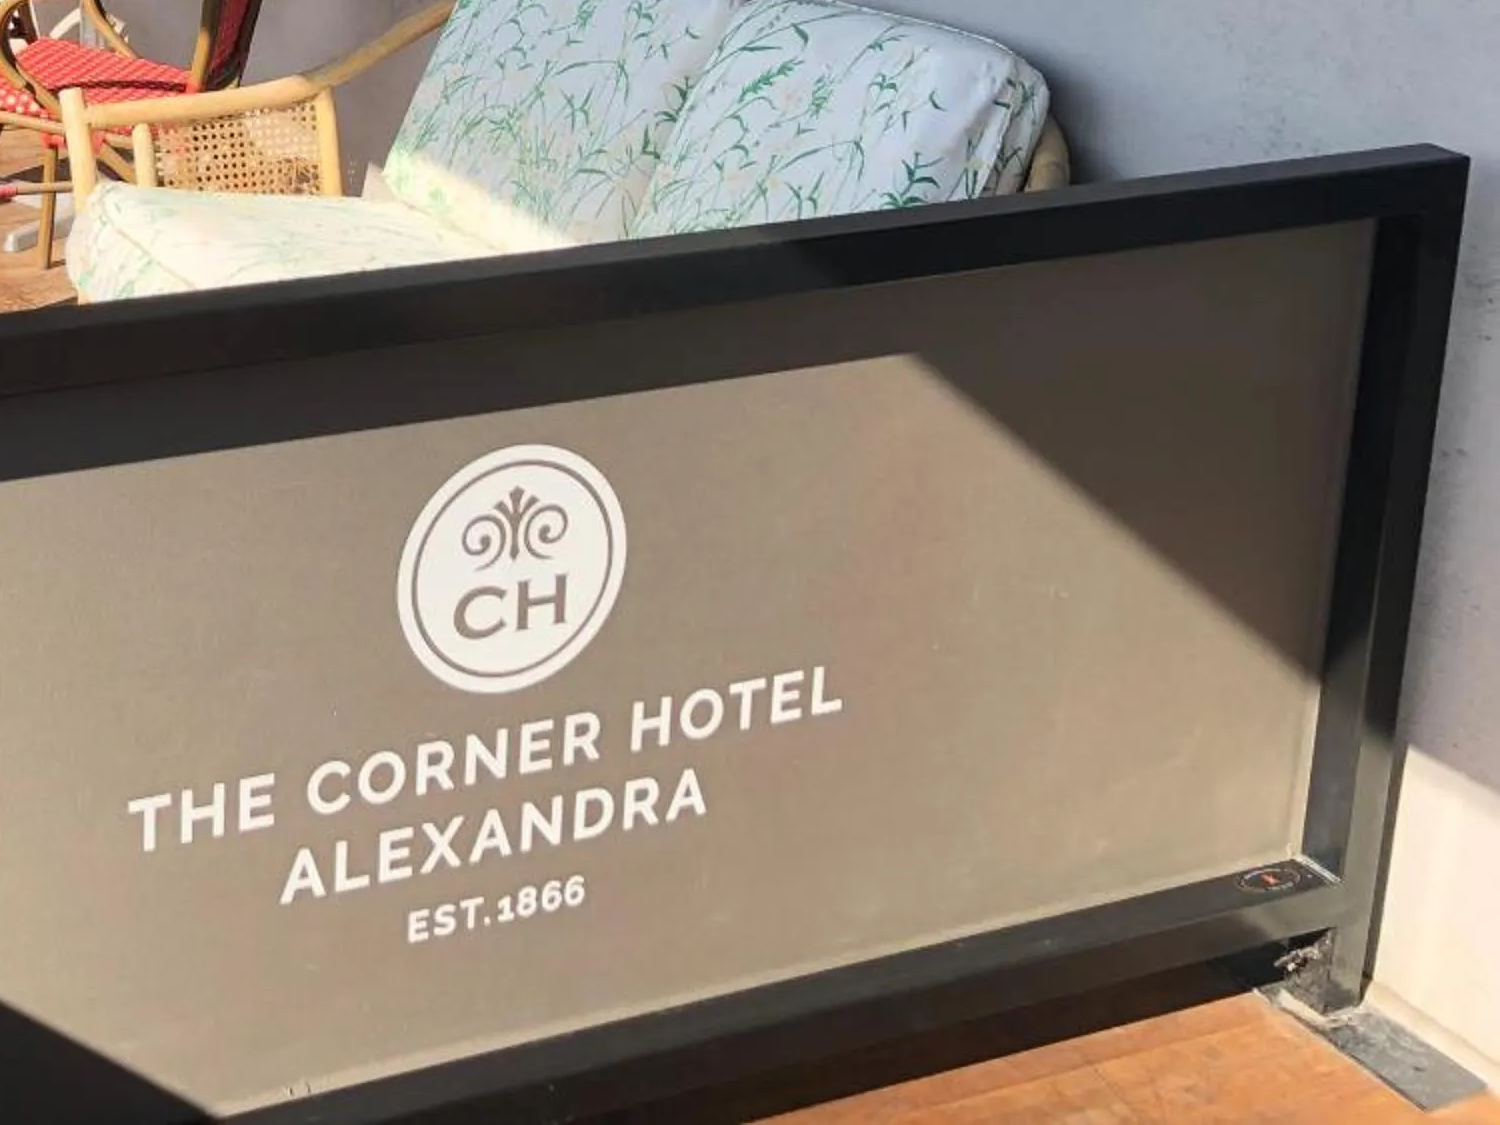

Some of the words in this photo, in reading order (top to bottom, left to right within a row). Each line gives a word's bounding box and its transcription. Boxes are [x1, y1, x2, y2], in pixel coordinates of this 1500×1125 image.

[452, 572, 569, 641] CH
[128, 773, 276, 852] THE
[306, 711, 601, 815] CORNER
[630, 665, 843, 752] HOTEL
[279, 768, 707, 905] ALEXANDRA
[407, 875, 586, 943] EST.1866
